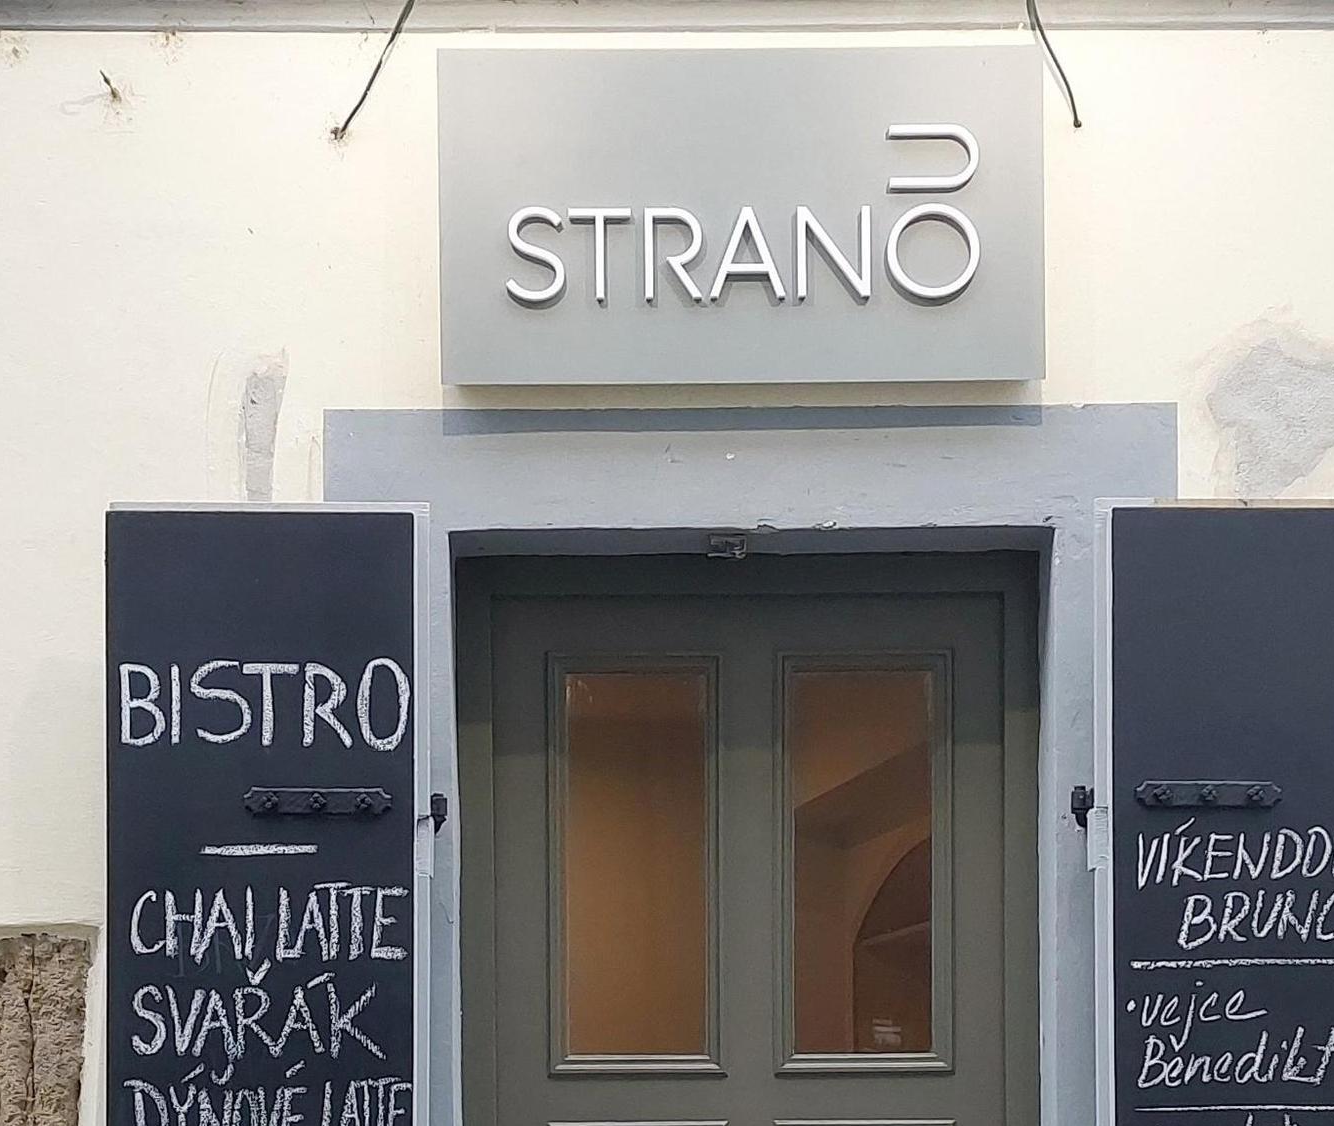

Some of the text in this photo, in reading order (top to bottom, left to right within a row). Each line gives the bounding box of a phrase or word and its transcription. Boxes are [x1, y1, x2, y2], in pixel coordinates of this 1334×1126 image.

[118, 657, 411, 751] BISTRO
[129, 881, 410, 965] CHAI LATTE
[130, 957, 387, 1060] SVAŘÁK
[1140, 980, 1267, 1052] vejce
